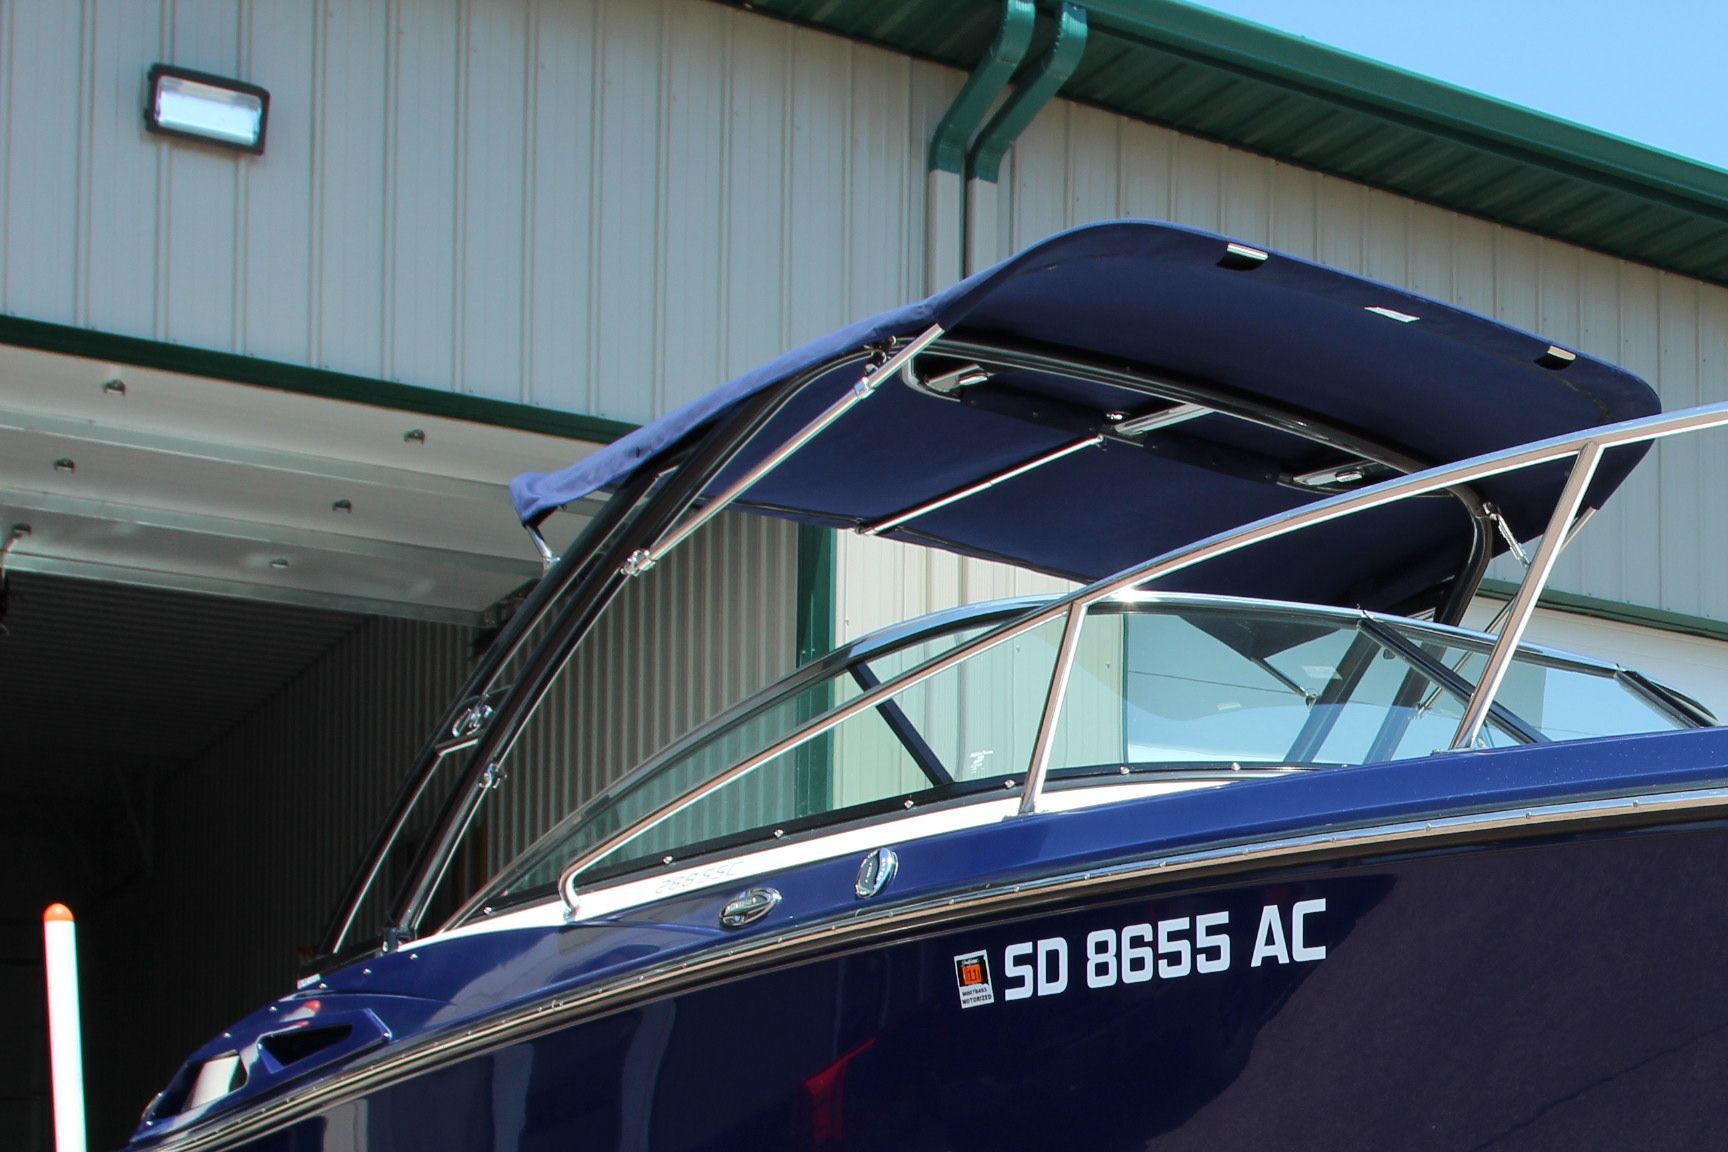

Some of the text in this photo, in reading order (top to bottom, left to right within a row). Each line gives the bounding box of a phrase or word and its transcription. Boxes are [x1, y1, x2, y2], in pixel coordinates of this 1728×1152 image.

[1004, 898, 1326, 1001] SD 8655 AC
